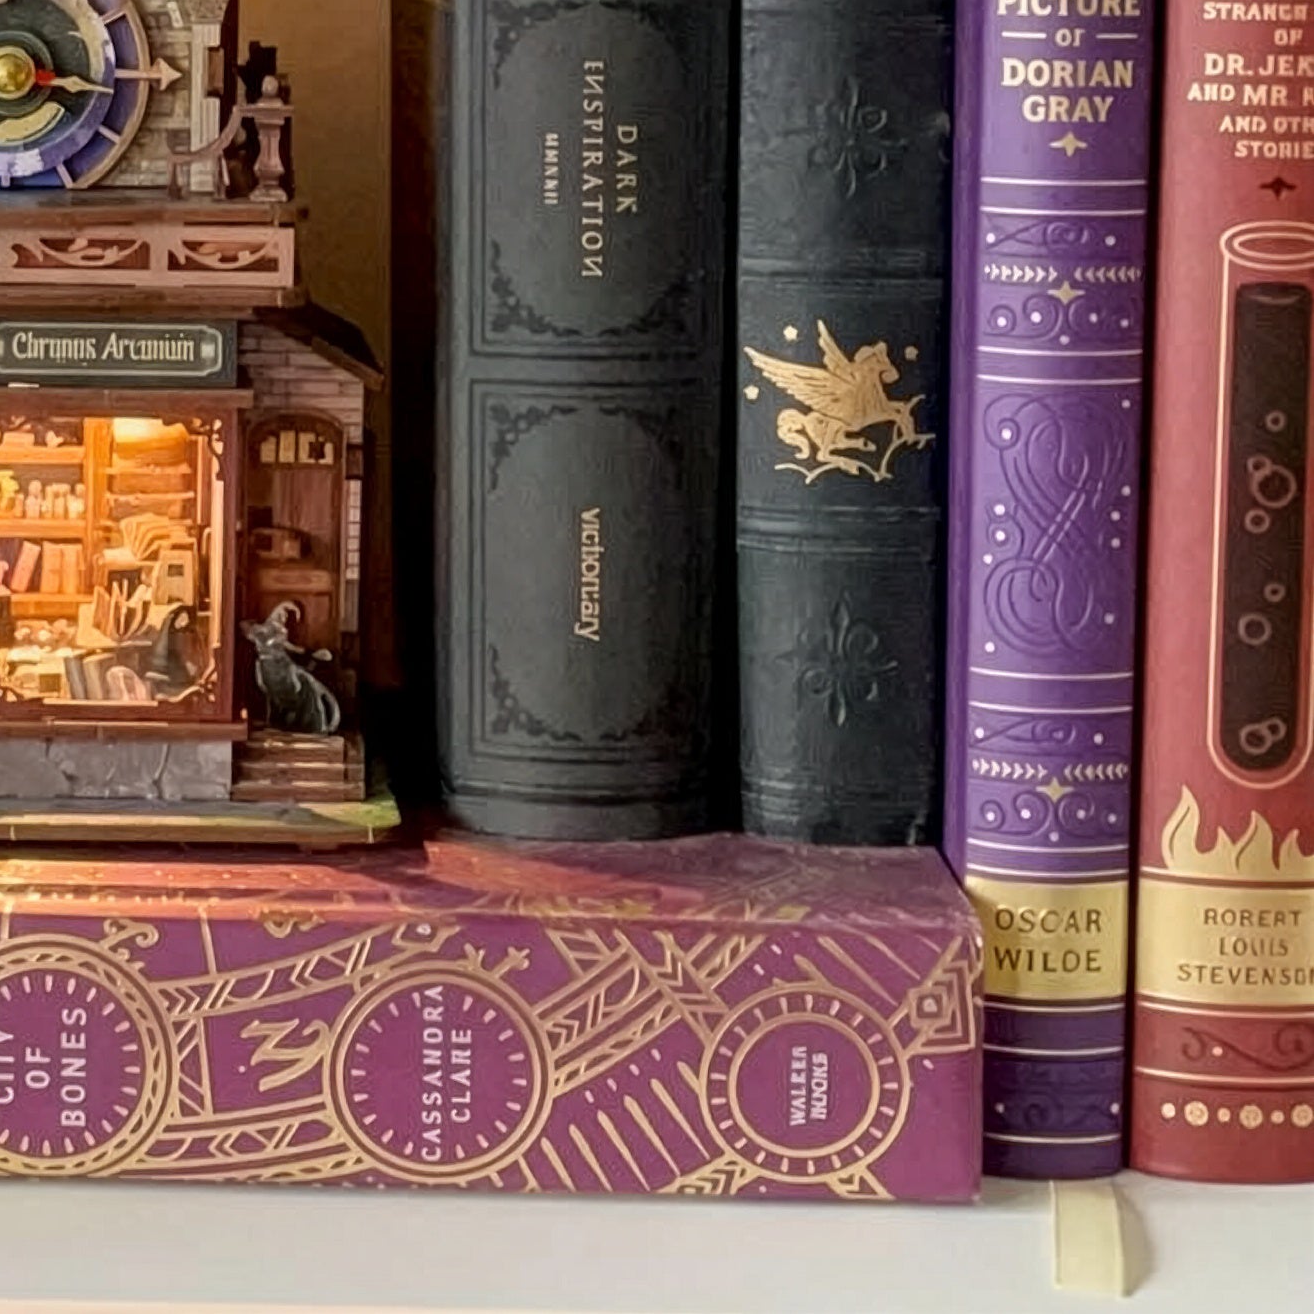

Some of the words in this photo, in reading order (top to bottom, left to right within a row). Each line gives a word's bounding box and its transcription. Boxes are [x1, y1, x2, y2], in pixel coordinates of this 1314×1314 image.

[1001, 57, 1134, 88] DORIAN
[1204, 53, 1254, 77] DR.
[1187, 82, 1236, 102] AND
[1022, 95, 1114, 123] GRAY
[1219, 114, 1267, 133] AND
[616, 125, 638, 212] DARK
[995, 908, 1101, 934] OSCAR
[25, 1047, 51, 1089] OF
[61, 1007, 86, 1127] BONES
[421, 986, 444, 1162] CASSANDRA
[450, 1029, 472, 1123] CLARE
